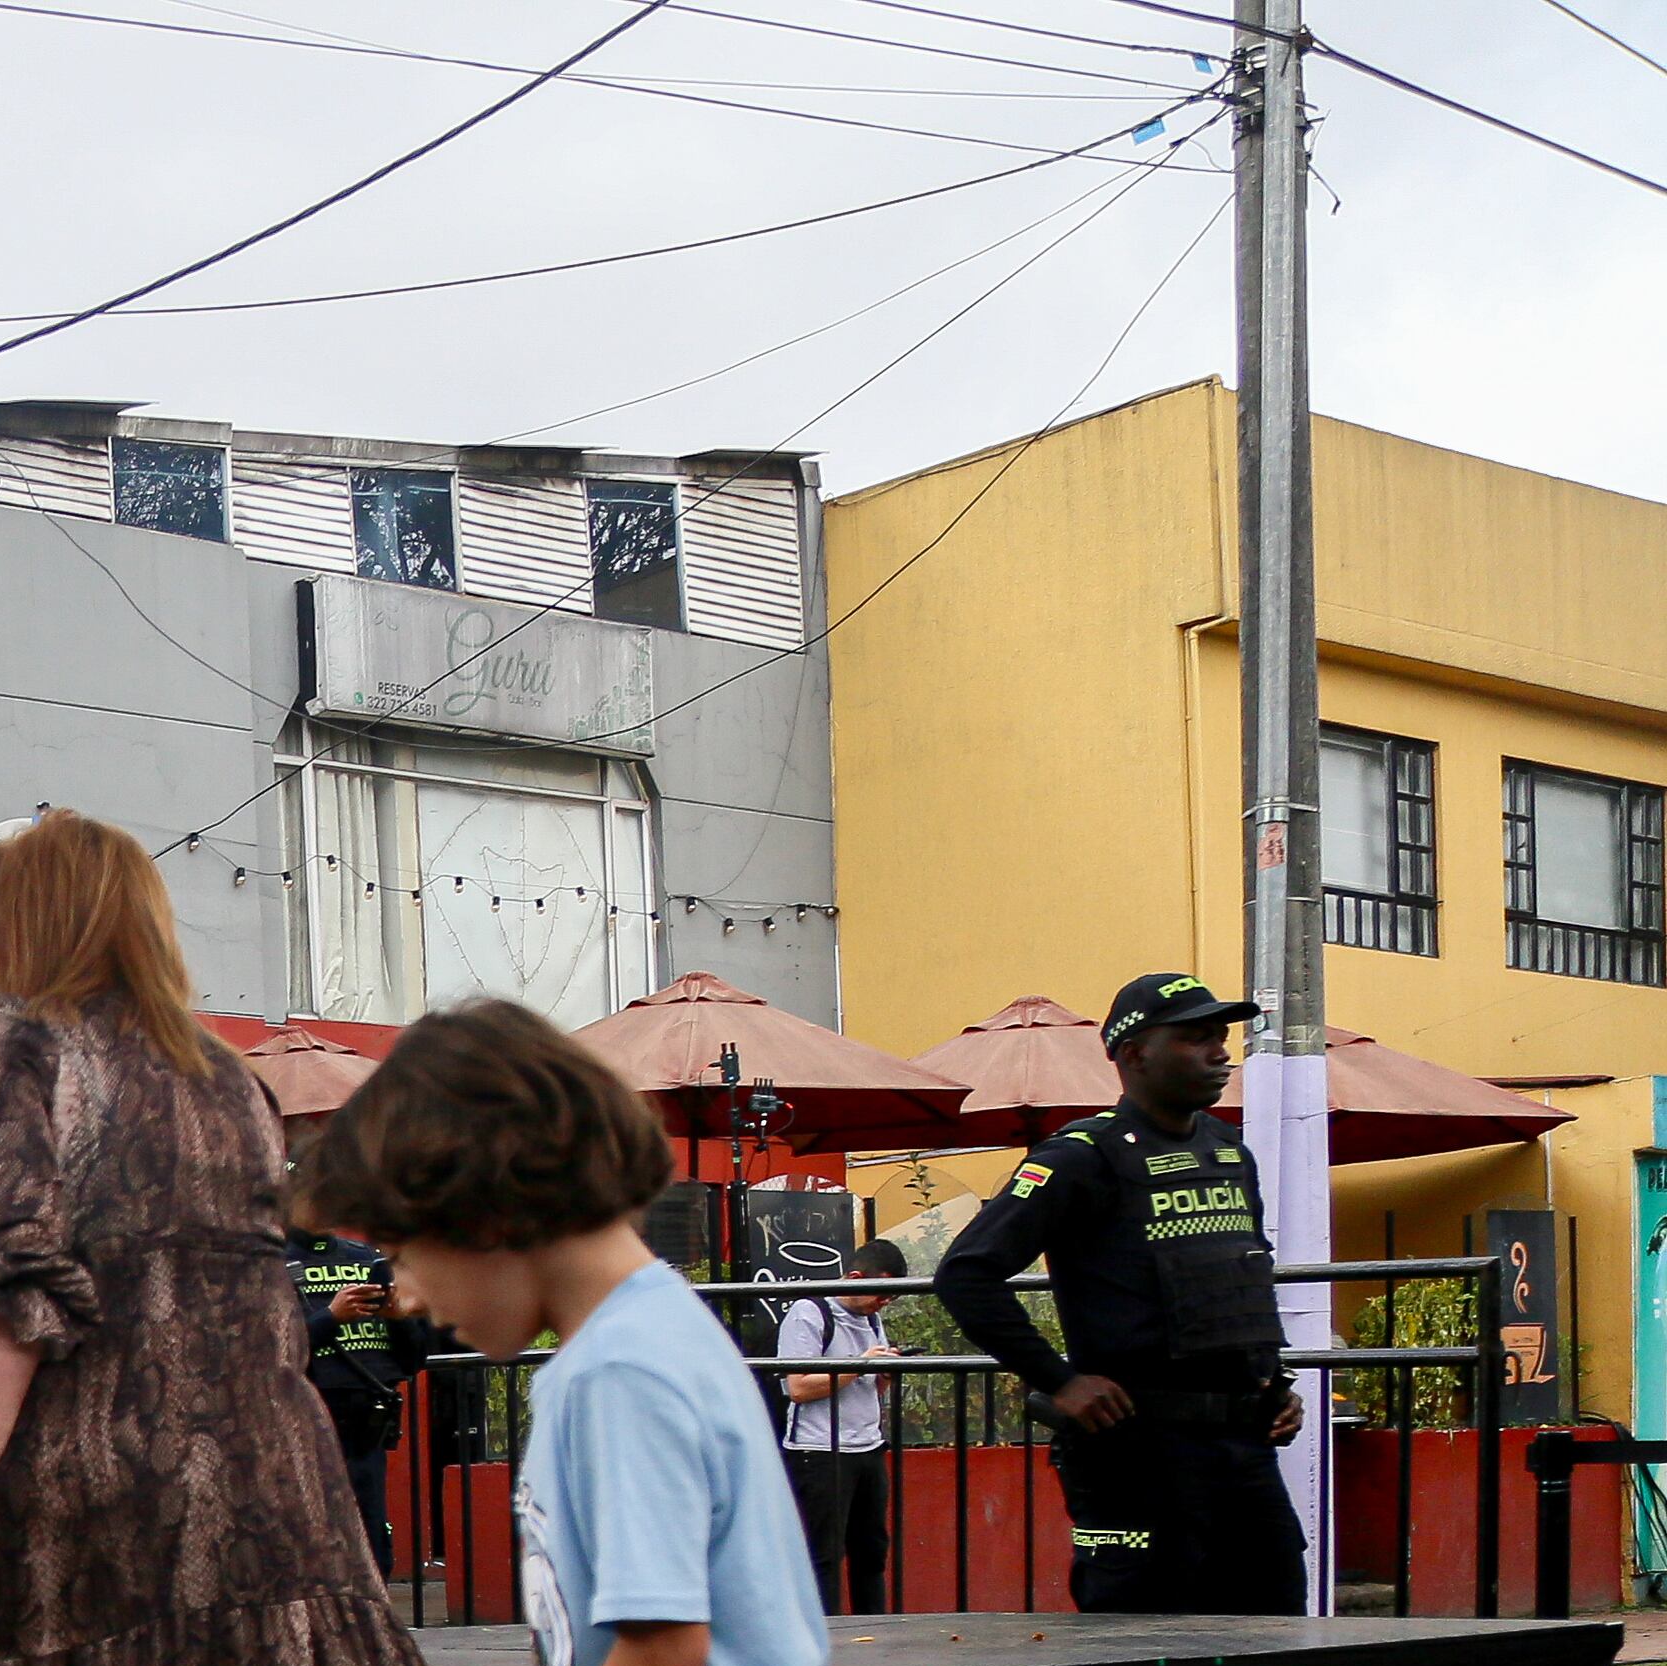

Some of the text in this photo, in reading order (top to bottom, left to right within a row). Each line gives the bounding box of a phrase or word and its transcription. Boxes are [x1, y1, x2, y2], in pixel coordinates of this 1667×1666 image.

[443, 607, 557, 717] Guru
[377, 681, 427, 700] RESERVAS
[367, 695, 387, 710] 322
[412, 702, 437, 717] 4581
[1151, 1182, 1248, 1216] POLICÍA
